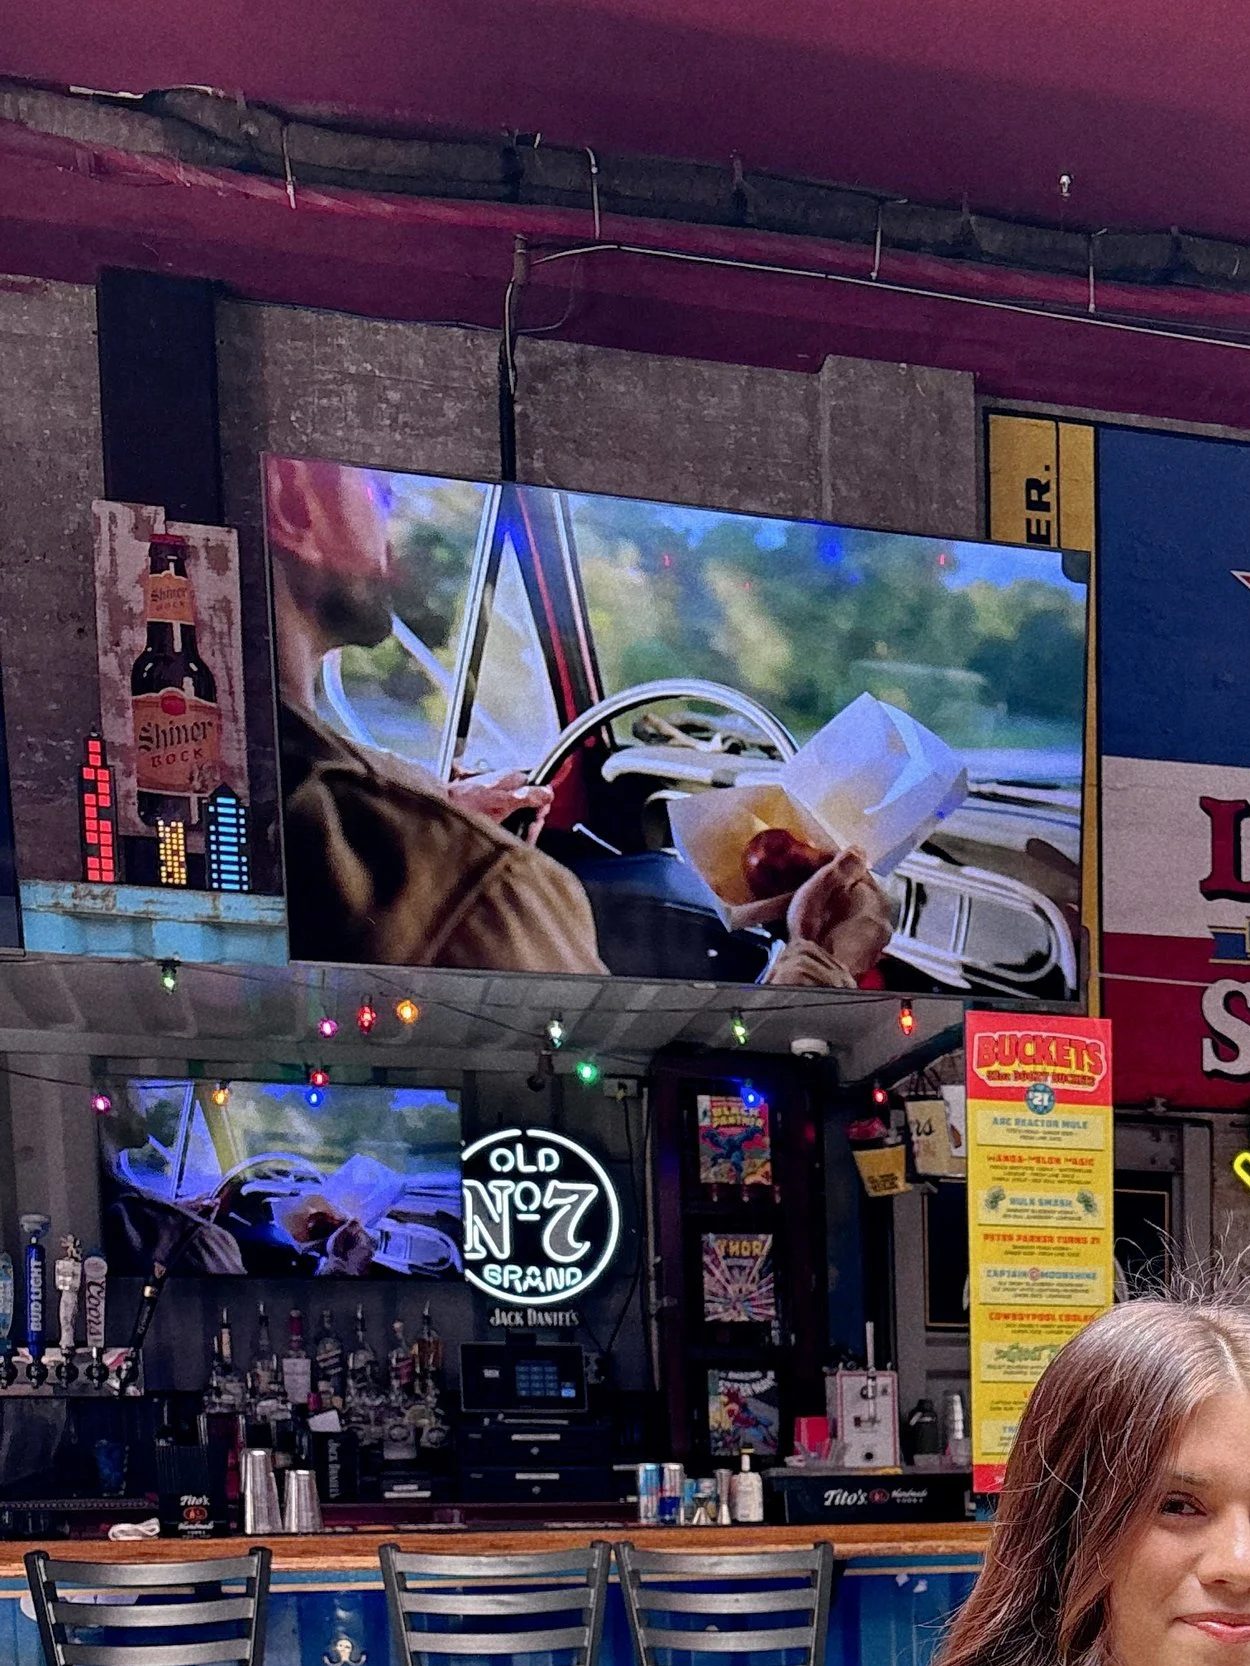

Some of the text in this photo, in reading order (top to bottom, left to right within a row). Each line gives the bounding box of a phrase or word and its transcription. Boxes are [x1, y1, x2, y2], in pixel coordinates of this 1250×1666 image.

[1024, 463, 1052, 545] ER.
[138, 720, 214, 753] Shiner
[151, 747, 203, 769] BOCK
[976, 1033, 1103, 1076] BUCKETS
[489, 1142, 560, 1173] OLD
[30, 1258, 43, 1332] BUD LIGHT
[87, 1280, 106, 1337] Coors
[489, 1307, 525, 1327] JACK
